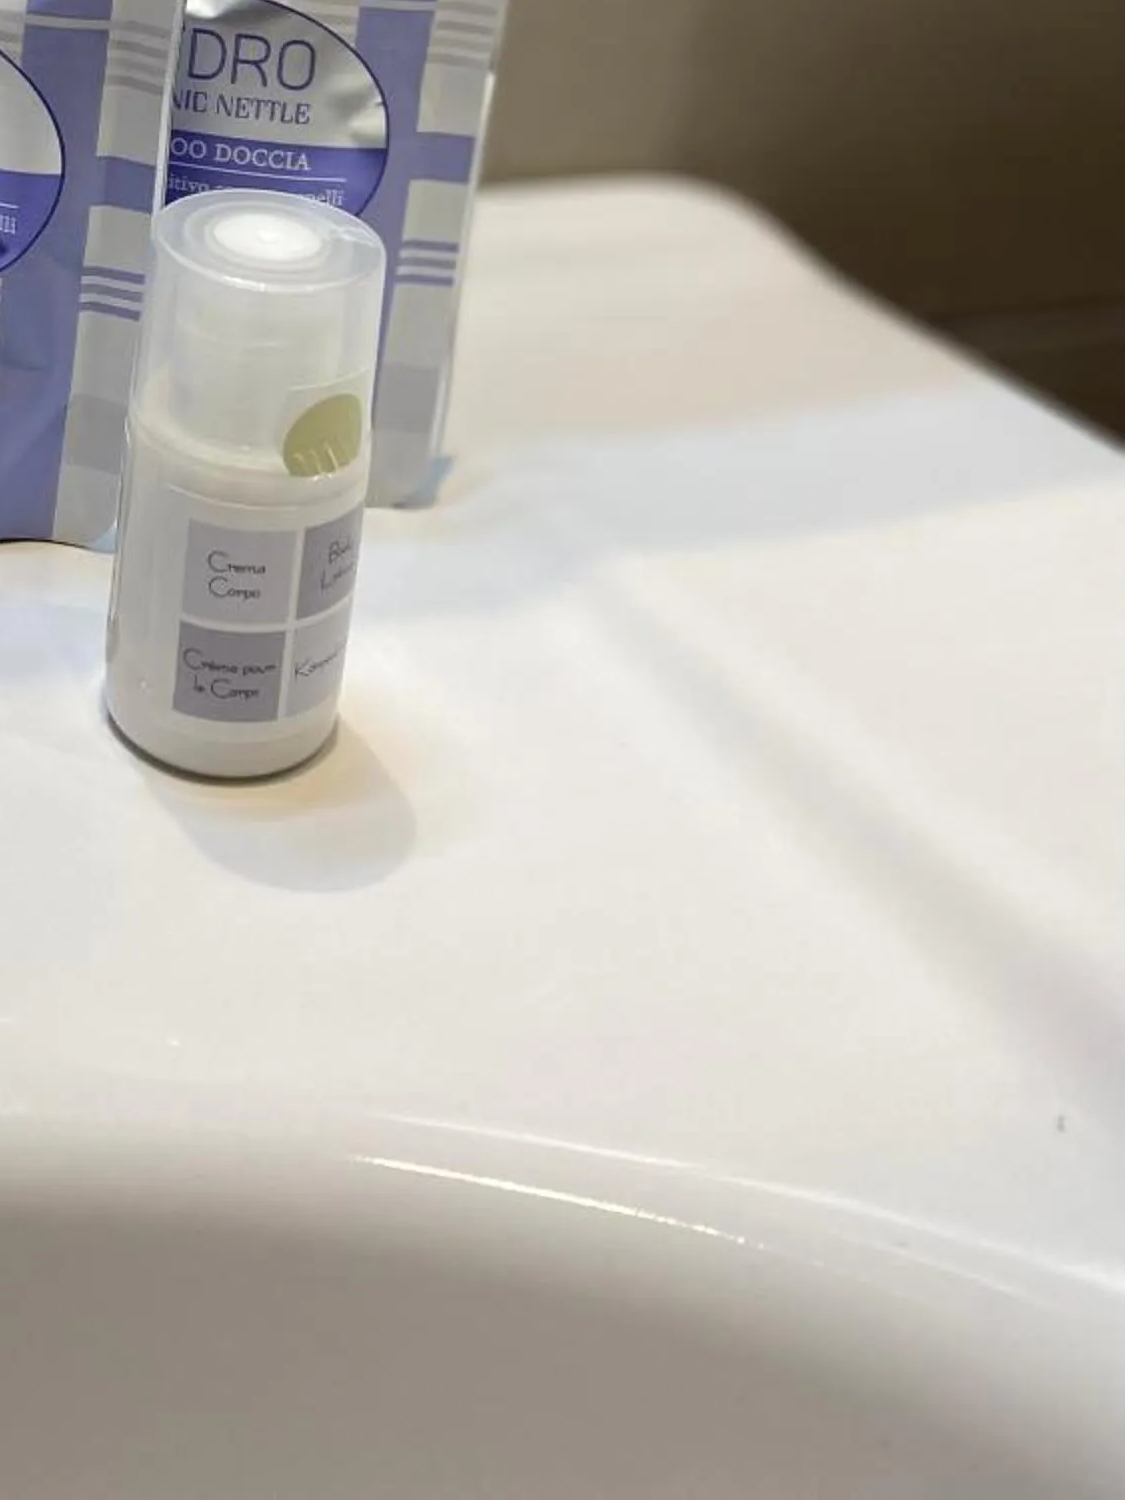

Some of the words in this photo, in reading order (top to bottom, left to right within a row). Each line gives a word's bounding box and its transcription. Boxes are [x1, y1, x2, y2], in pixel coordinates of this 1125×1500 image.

[187, 27, 316, 91] DRO
[216, 94, 311, 125] NETTLE
[214, 143, 311, 171] DOCCIA
[207, 550, 266, 574] Crema
[208, 576, 261, 601] Corpo
